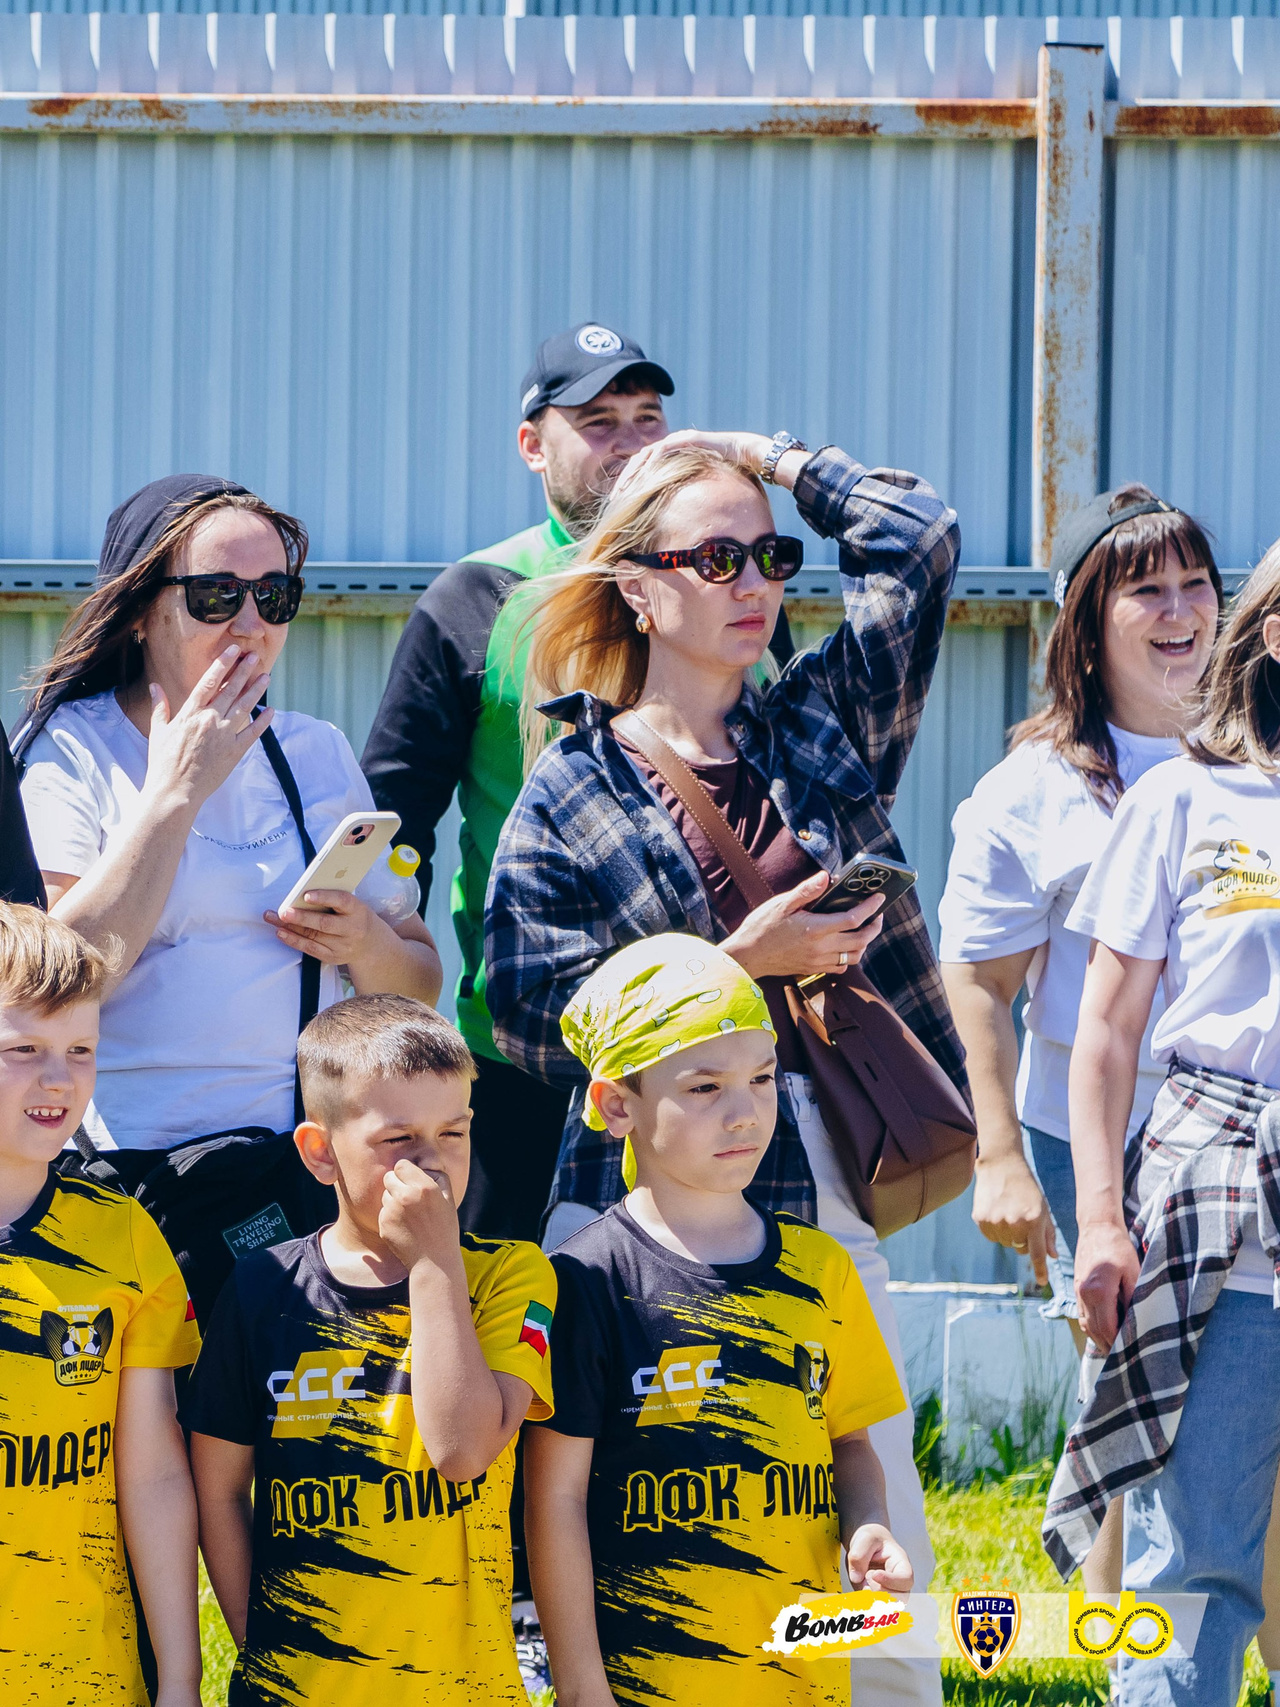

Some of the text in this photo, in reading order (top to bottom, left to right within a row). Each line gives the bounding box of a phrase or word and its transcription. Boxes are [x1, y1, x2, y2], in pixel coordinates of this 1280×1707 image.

[1217, 871, 1277, 894] ДФК ЛИДЕР
[232, 1216, 282, 1248] TRAVELING
[238, 1215, 269, 1237] LIVING
[246, 1229, 277, 1250] SHARE
[60, 1360, 102, 1378] ДФК ЛИДЕР
[271, 1474, 361, 1538] ДФК
[623, 1461, 838, 1533] ДФК ЛИДЕ
